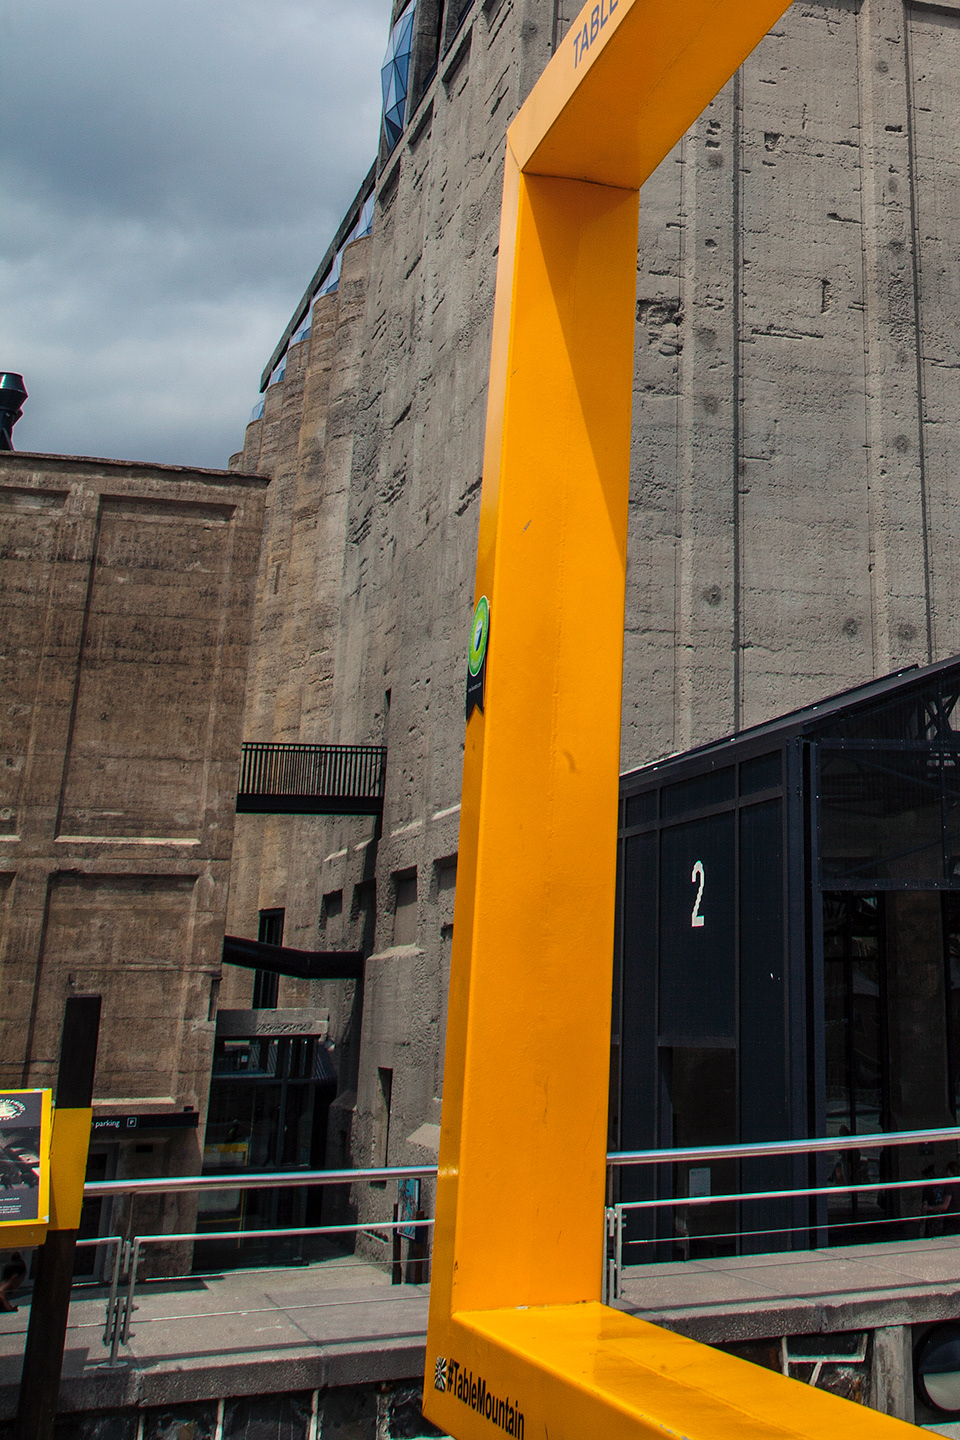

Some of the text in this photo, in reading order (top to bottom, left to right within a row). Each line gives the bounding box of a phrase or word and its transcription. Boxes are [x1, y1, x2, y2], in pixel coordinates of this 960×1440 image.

[691, 860, 705, 928] 2
[95, 1119, 121, 1129] parking
[447, 1357, 525, 1440] #TableMountain
